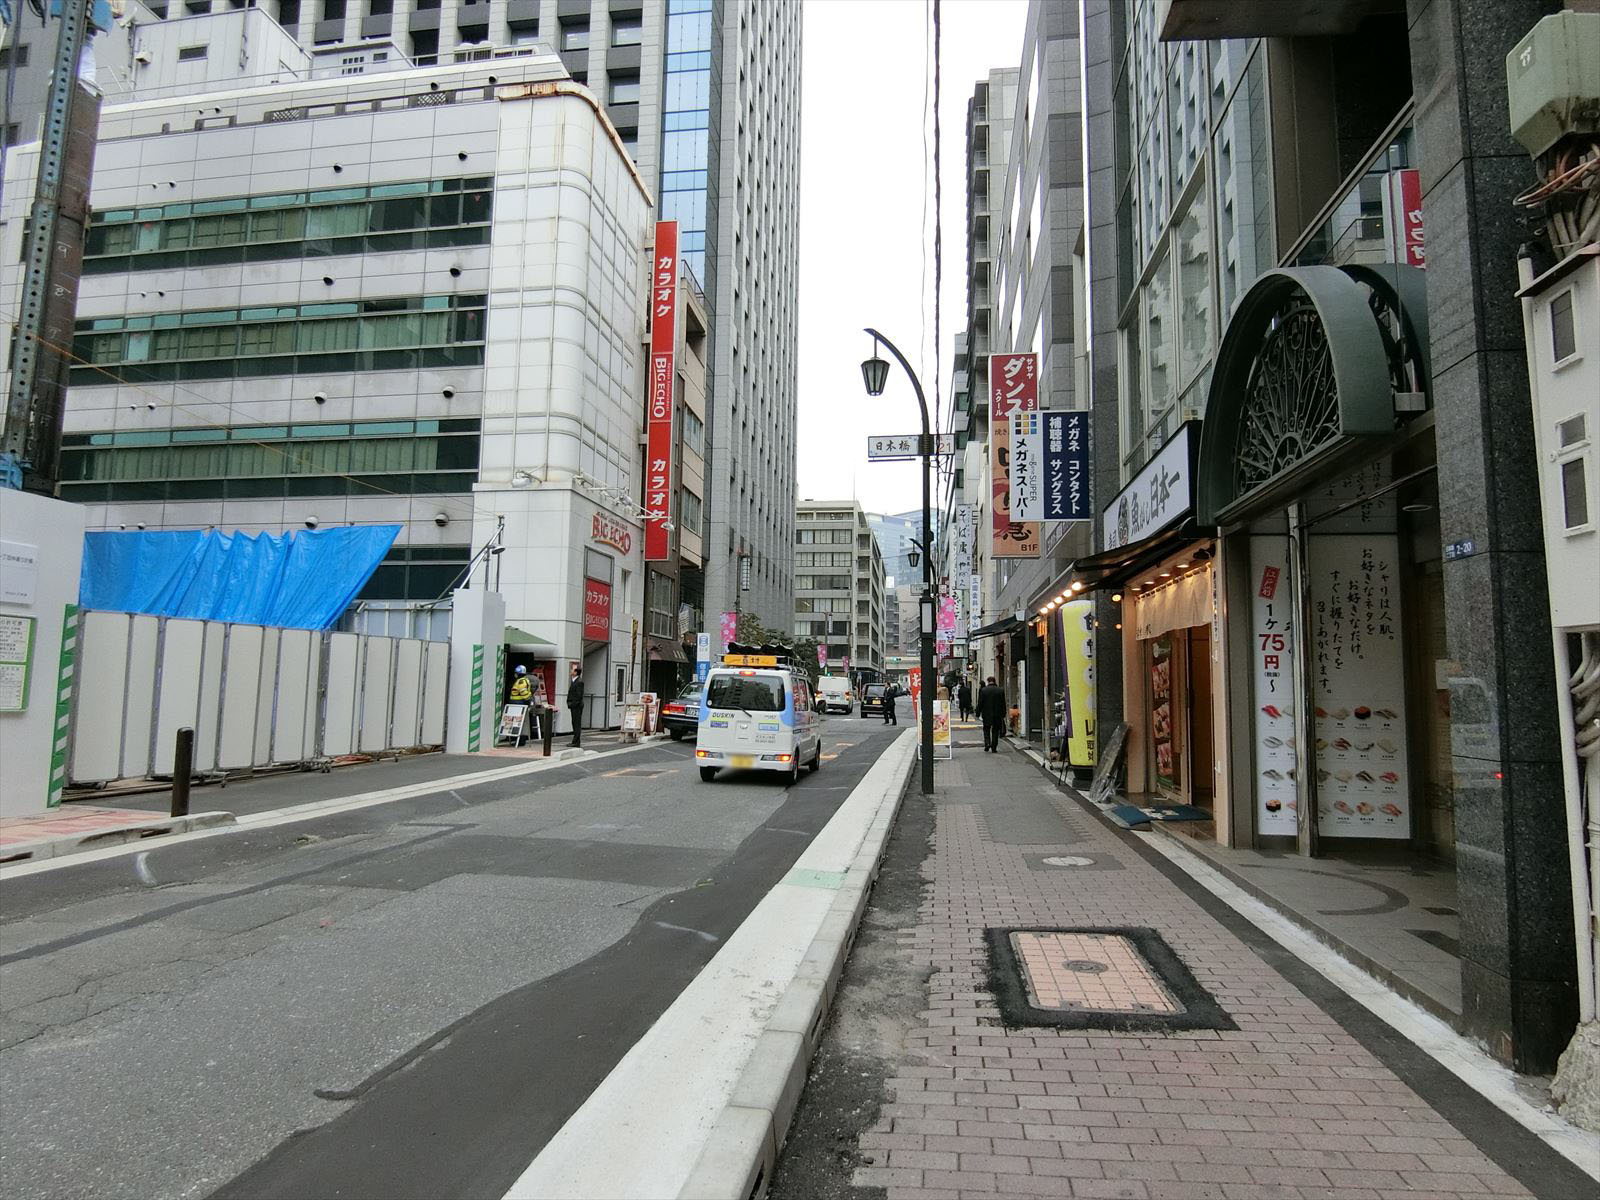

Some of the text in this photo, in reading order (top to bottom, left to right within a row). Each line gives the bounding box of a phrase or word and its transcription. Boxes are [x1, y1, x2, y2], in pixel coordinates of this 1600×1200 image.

[657, 256, 673, 317] カラオケ
[653, 357, 667, 418] BIG ECHO
[995, 389, 1004, 417] スクール
[1003, 356, 1026, 417] ダンス
[875, 440, 911, 452] 日本橋
[1049, 416, 1063, 453] 補聴器
[1068, 416, 1081, 514] メガネ コンタクト
[650, 458, 666, 522] カラオケ
[1015, 438, 1029, 518] メガネスーパー
[1050, 459, 1063, 515] サングラス
[1131, 464, 1181, 536] 魚がし日本一
[592, 514, 609, 538] BIG
[610, 526, 631, 553] ECHO
[1020, 543, 1038, 552] B1F
[1456, 541, 1472, 555] 2-20
[586, 590, 609, 606] カラオケ
[1328, 569, 1345, 670] すぐに握りたてを
[1346, 579, 1364, 660] お好きなだけ。
[1360, 548, 1376, 636] お好きなネタを
[1378, 560, 1395, 641] シャリは人肌。
[1315, 600, 1333, 695] 召しあがれます。
